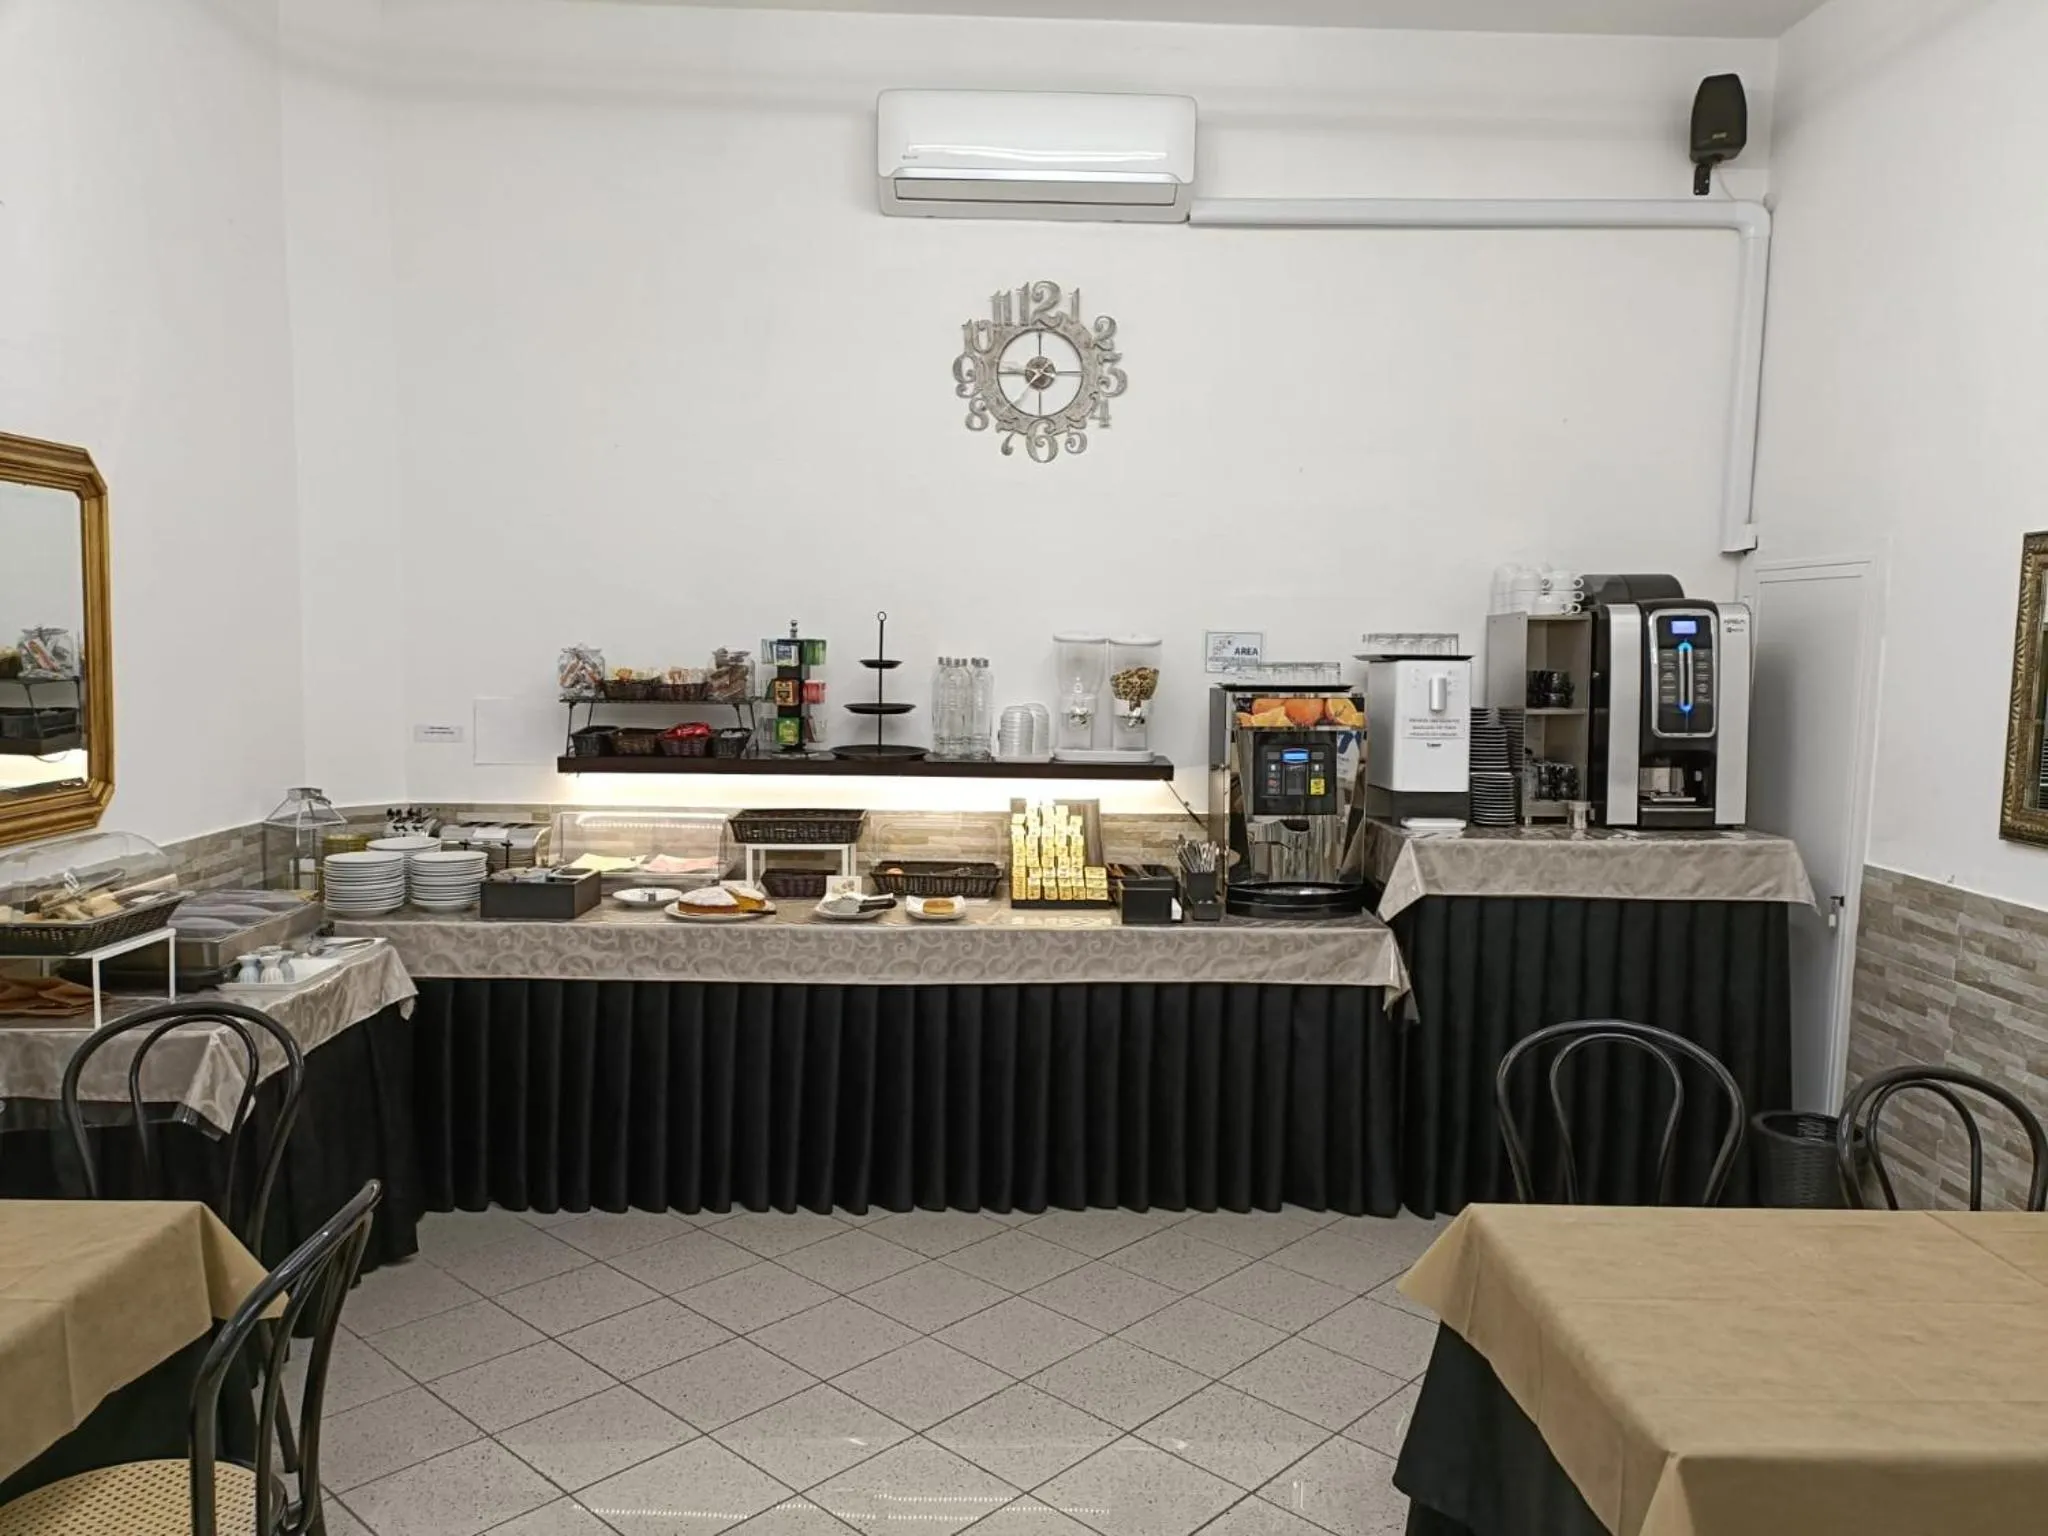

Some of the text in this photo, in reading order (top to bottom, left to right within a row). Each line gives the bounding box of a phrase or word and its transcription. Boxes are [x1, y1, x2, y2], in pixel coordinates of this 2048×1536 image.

[990, 290, 1012, 326] 11
[1016, 280, 1062, 329] 12
[1068, 287, 1081, 324] 1
[961, 319, 995, 355] 10
[1093, 315, 1117, 351] 2
[953, 351, 981, 399] 9
[1097, 352, 1128, 398] 3
[965, 397, 989, 432] 8
[1088, 391, 1112, 429] 4
[1026, 418, 1059, 463] 6
[1064, 415, 1088, 455] 5
[1234, 646, 1258, 656] AREA
